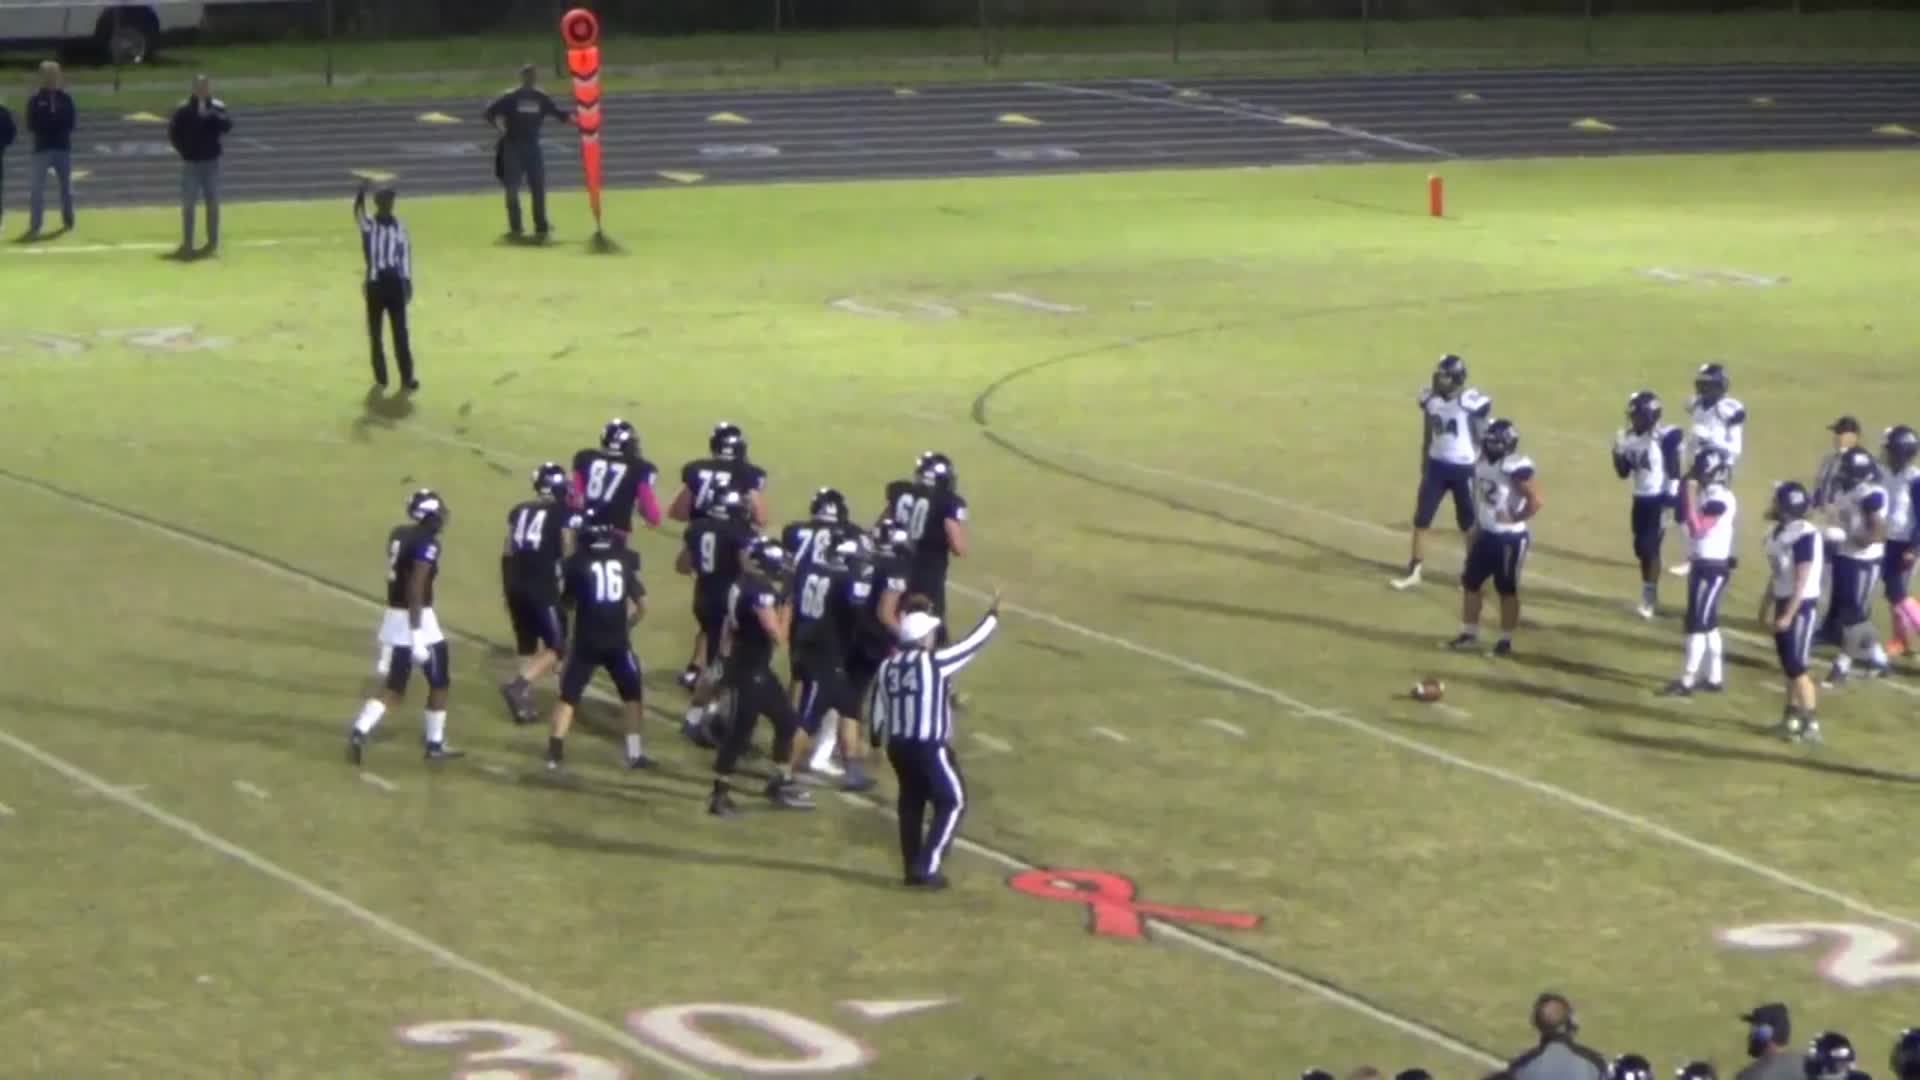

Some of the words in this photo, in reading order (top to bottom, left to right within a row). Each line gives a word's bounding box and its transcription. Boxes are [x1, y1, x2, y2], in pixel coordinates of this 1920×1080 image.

[587, 458, 627, 501] 87
[700, 531, 716, 573] 9
[590, 559, 623, 602] 16
[888, 667, 917, 692] 34
[398, 1002, 877, 1080] 30
